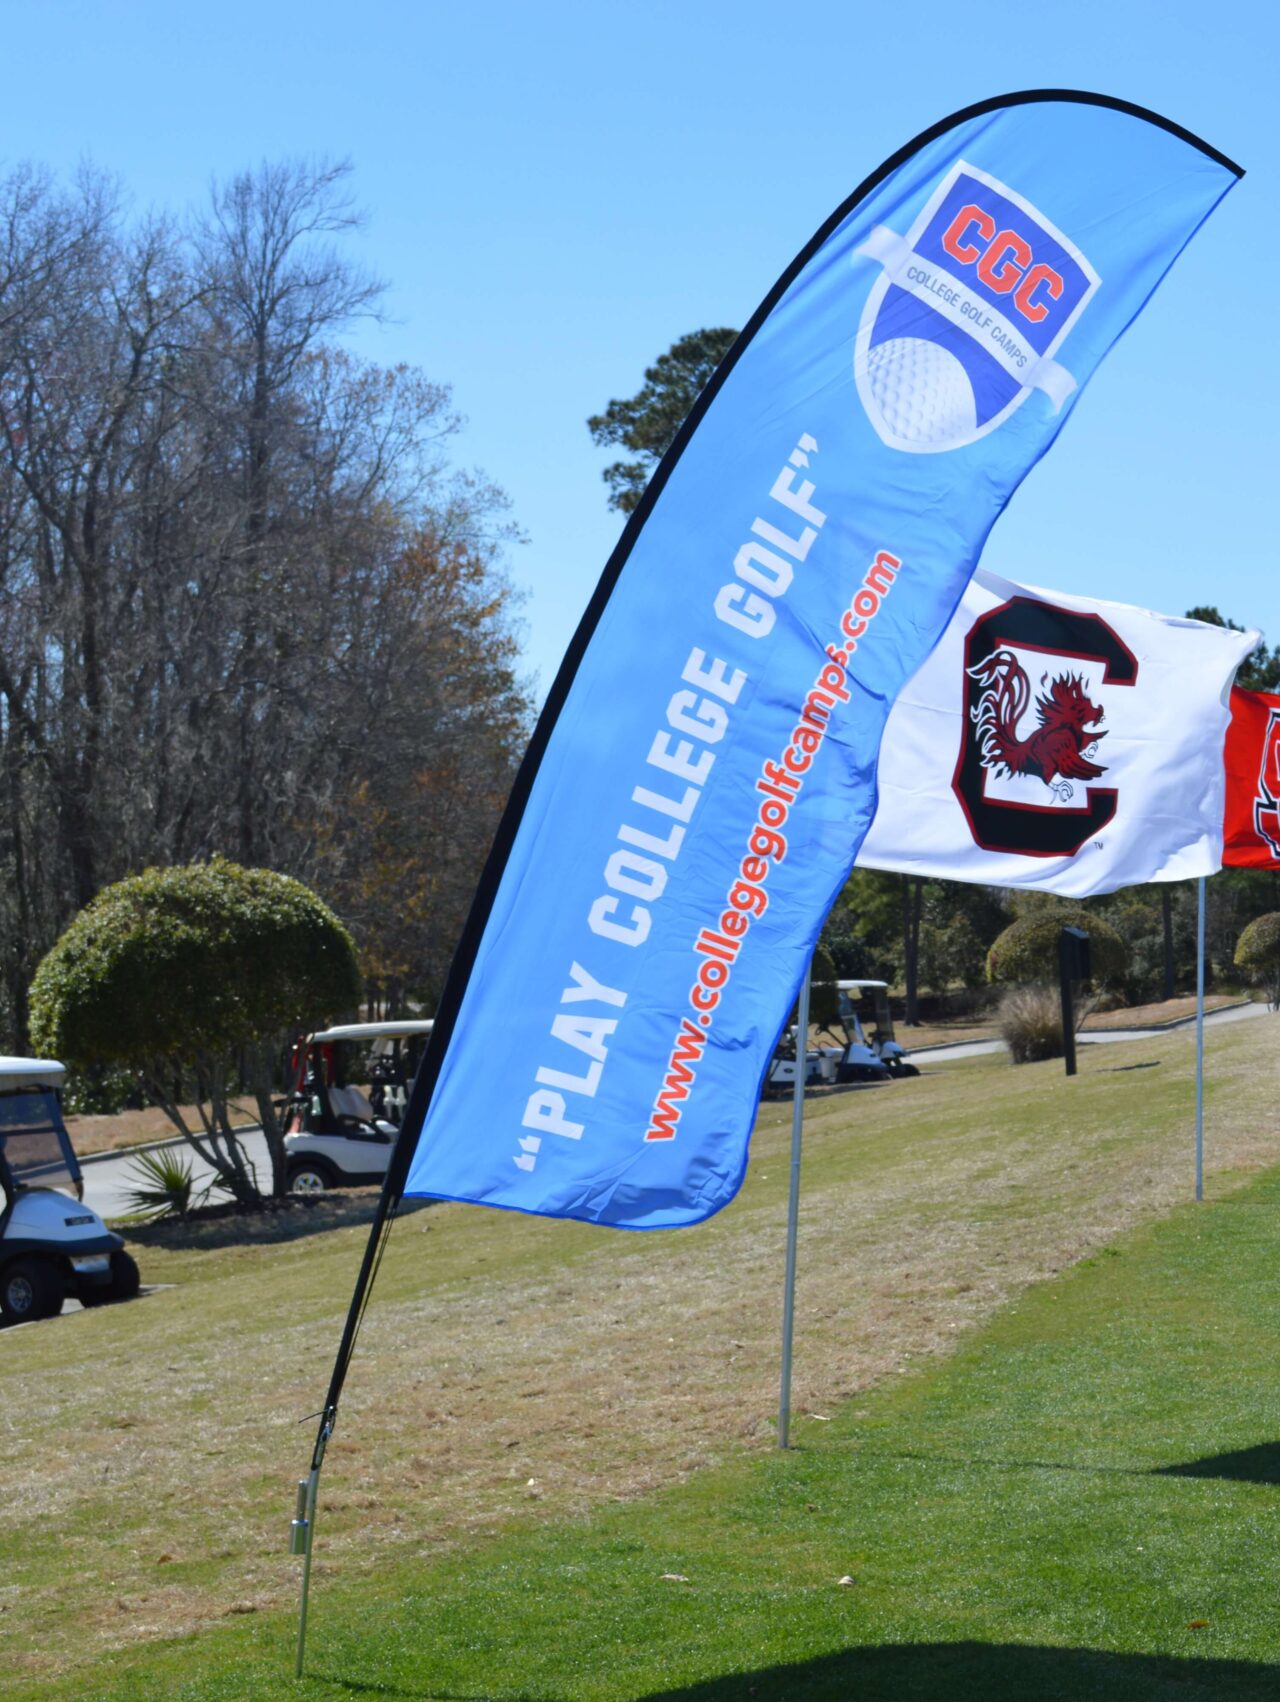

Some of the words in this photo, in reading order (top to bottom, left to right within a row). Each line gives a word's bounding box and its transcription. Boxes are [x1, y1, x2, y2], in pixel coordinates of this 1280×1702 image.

[906, 266, 961, 307] COLLEGE
[960, 301, 993, 329] GOLF
[990, 326, 1028, 368] CAMPS
[941, 204, 1064, 324] CGC
[587, 647, 748, 947] COLLEGE
[644, 549, 902, 1143] www.collegegolfcamps.com
